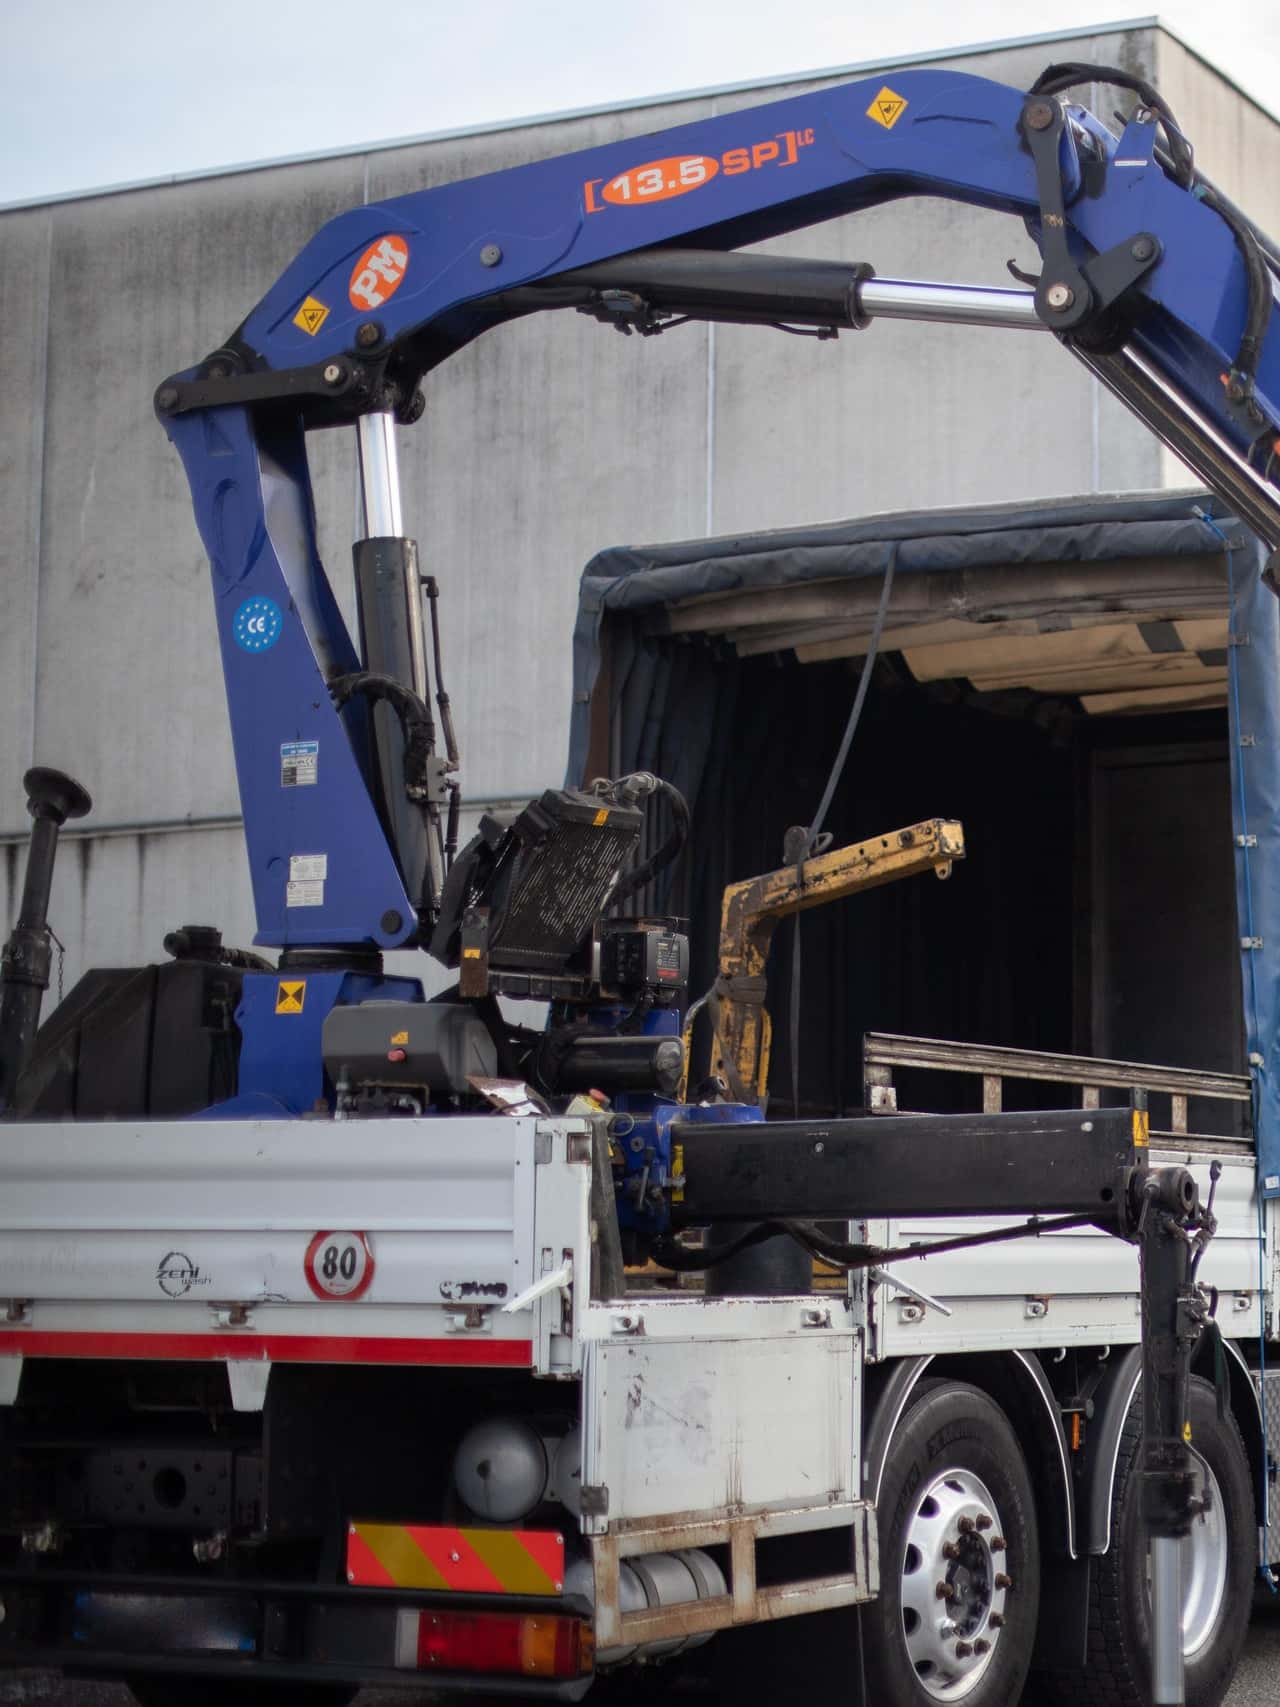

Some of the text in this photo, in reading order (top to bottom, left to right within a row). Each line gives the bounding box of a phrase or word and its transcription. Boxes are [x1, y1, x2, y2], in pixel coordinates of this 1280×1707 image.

[351, 239, 408, 308] PM
[247, 616, 265, 634] CE
[323, 1246, 357, 1281] 80
